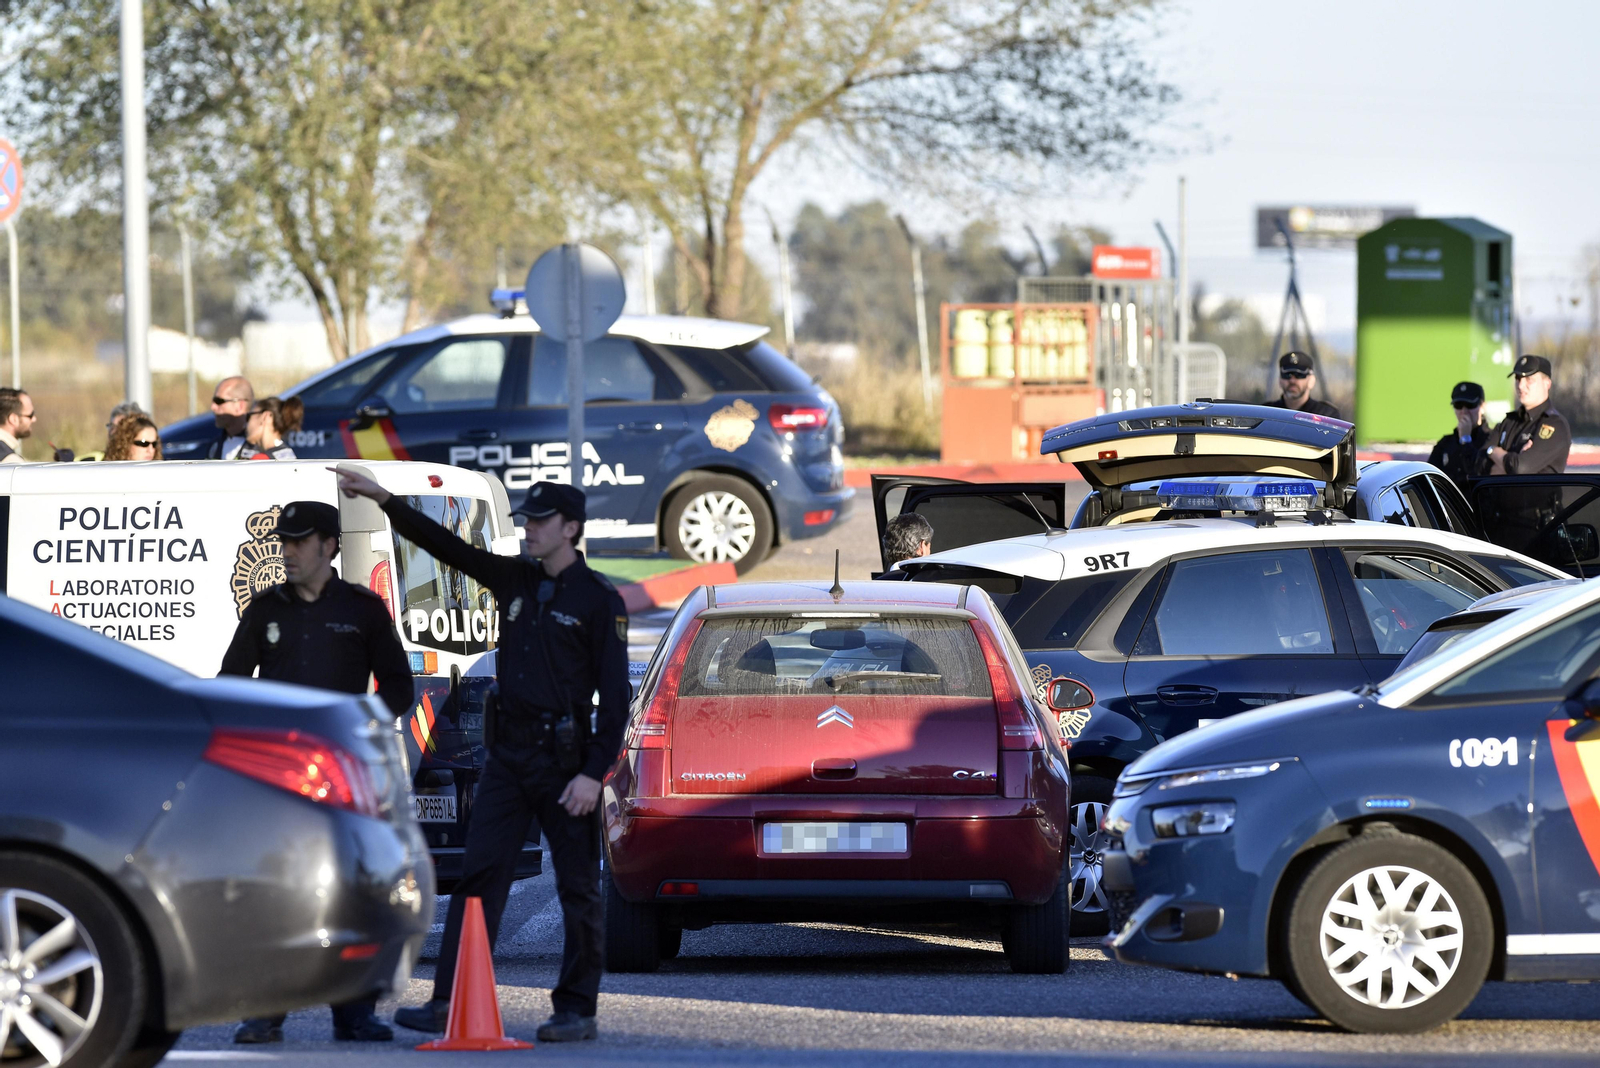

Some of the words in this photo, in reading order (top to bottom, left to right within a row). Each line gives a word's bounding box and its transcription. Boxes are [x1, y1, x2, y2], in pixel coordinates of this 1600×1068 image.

[295, 430, 325, 447] 091
[59, 501, 183, 530] POLICÍA
[33, 533, 208, 563] CIENTÍFICA
[1083, 551, 1130, 572] 9R7
[50, 579, 195, 596] LABORATORIO
[50, 601, 195, 619] ACTUACIONES
[1462, 736, 1519, 767] 091
[680, 771, 746, 781] CITROËN
[952, 769, 986, 780] C4
